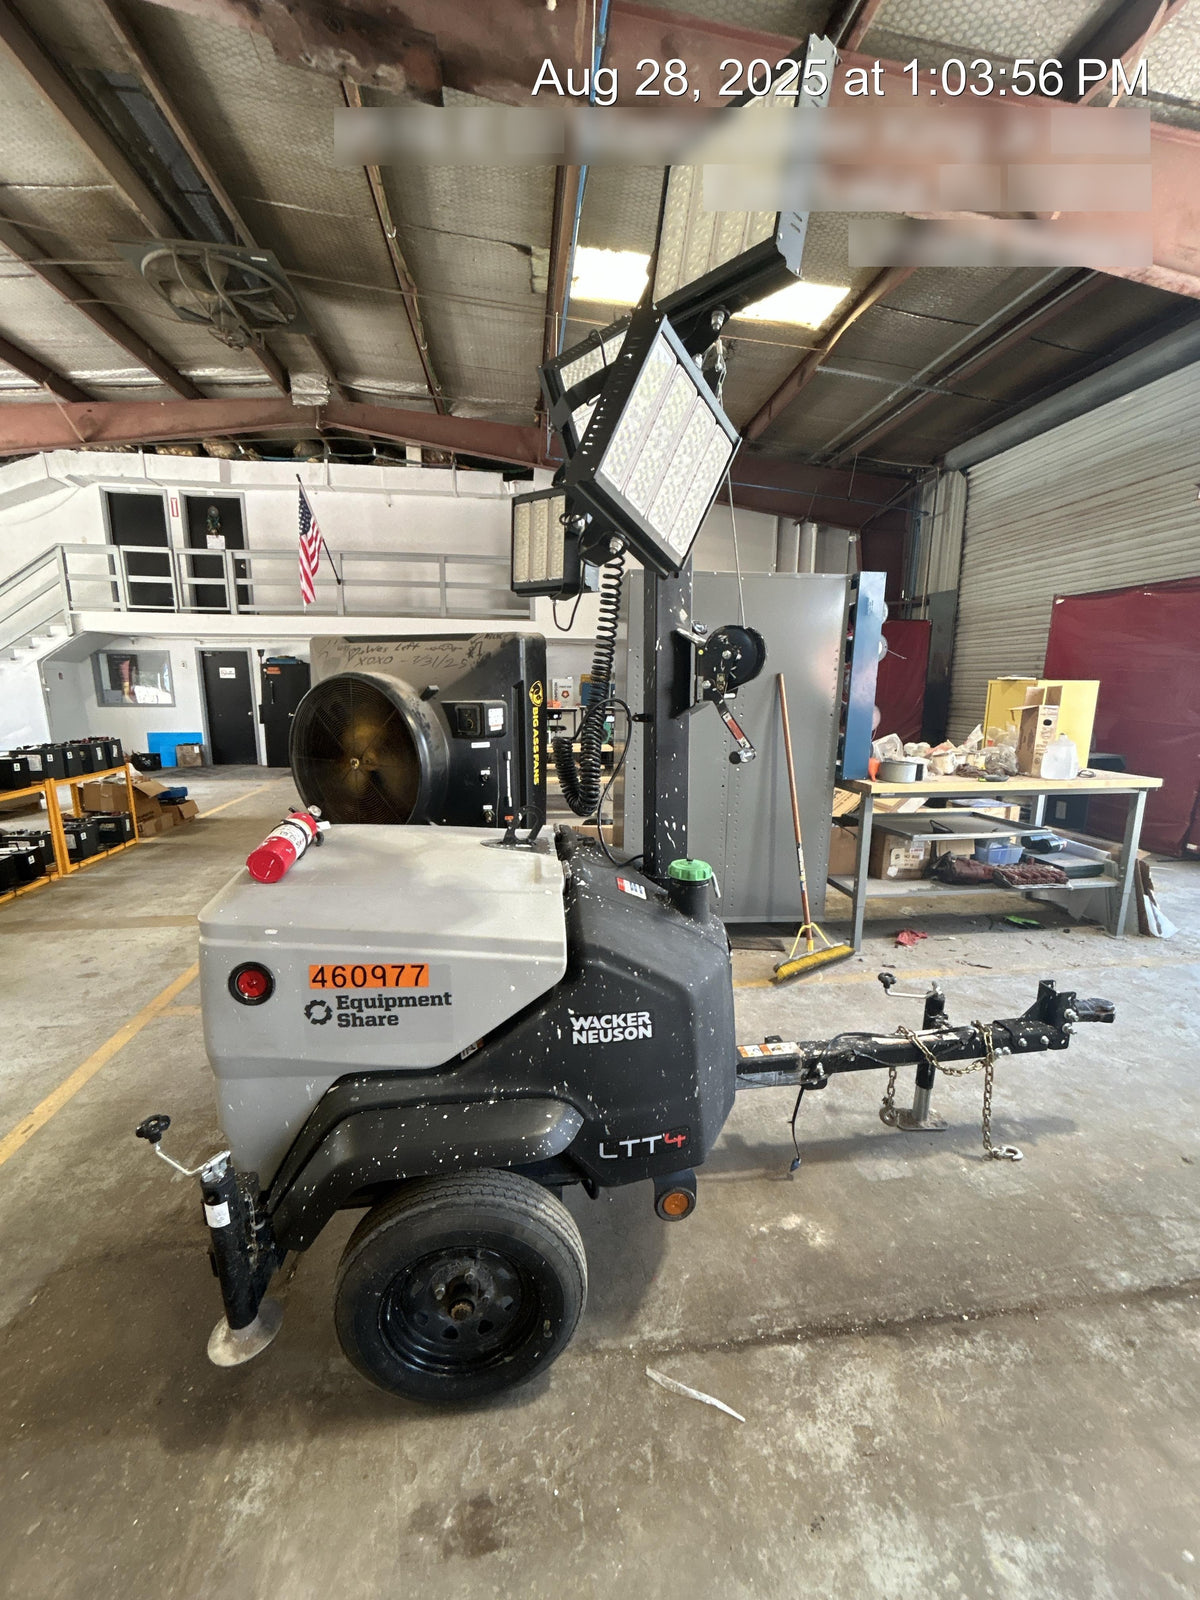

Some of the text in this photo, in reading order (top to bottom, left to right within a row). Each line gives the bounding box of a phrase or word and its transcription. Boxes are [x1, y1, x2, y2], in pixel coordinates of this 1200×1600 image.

[532, 728, 540, 753] ASS
[311, 964, 426, 989] 460977
[335, 991, 453, 1013] Equipment
[336, 1012, 400, 1028] Share
[570, 1011, 653, 1031] WACKER
[572, 1025, 653, 1045] NEUSON
